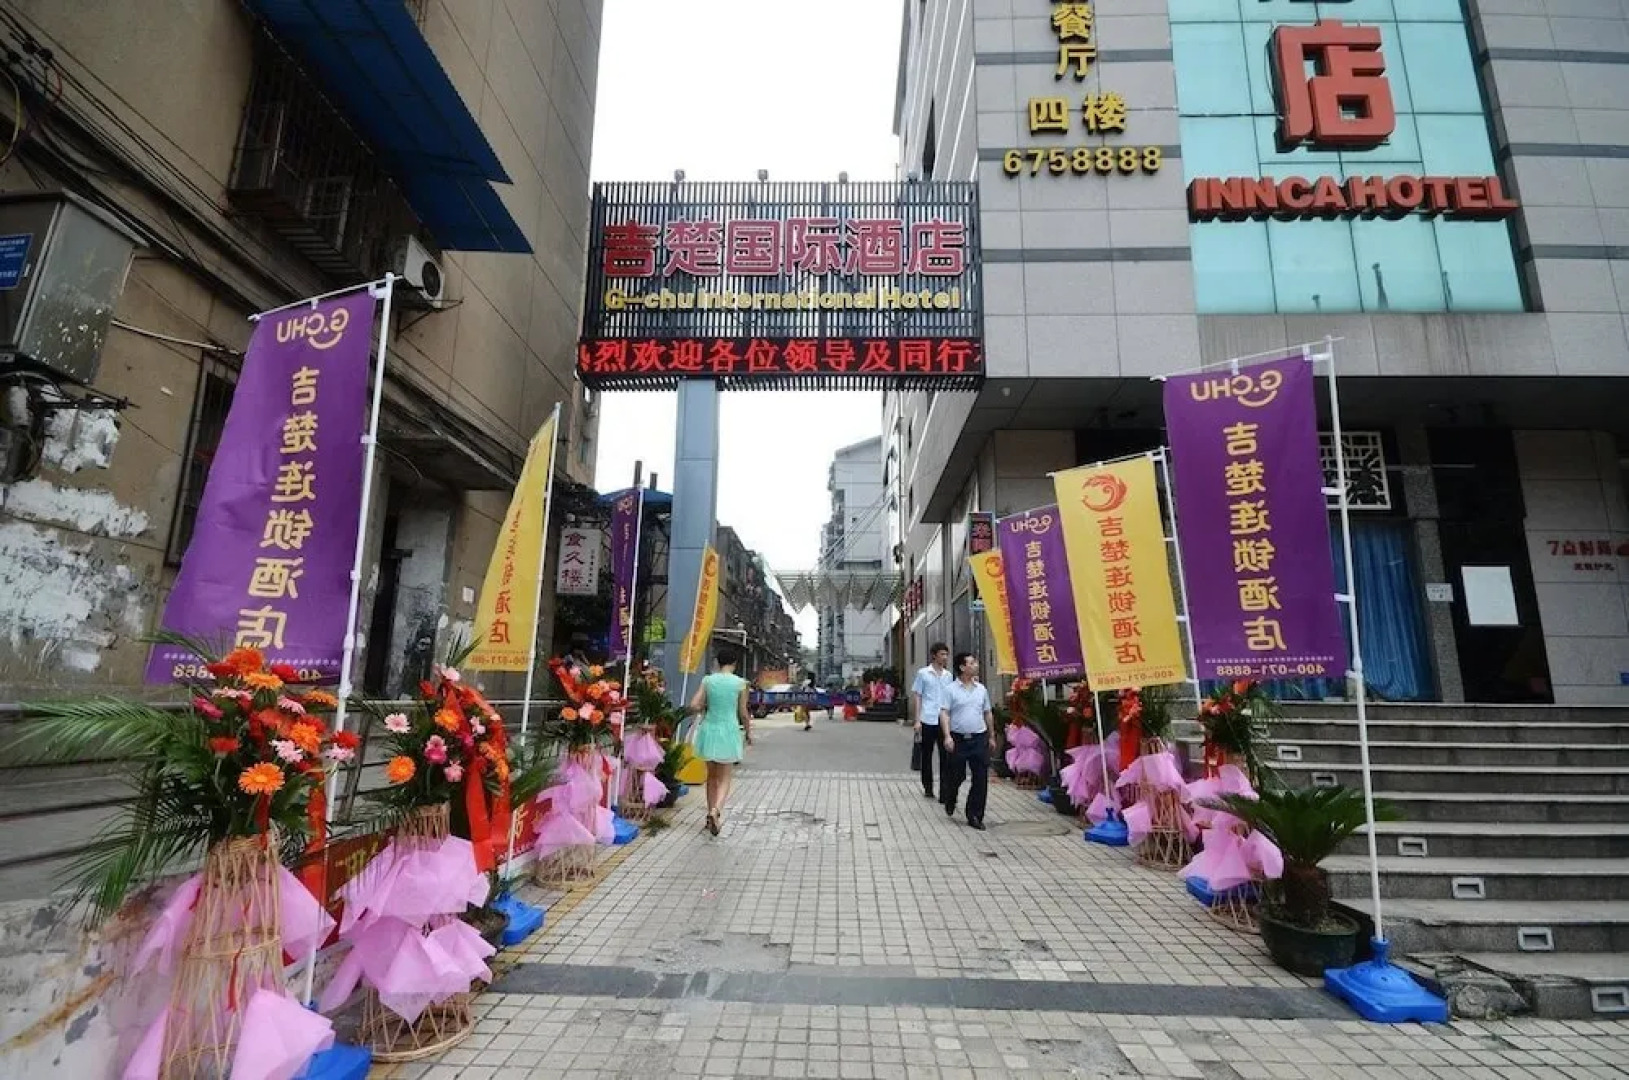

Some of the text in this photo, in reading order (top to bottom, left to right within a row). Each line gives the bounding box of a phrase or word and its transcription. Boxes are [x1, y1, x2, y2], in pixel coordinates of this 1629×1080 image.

[1052, 3, 1097, 78] 餐厅
[1028, 91, 1127, 133] 四楼
[1003, 146, 1163, 176] 6758888
[1350, 175, 1518, 216] HOTEL
[603, 217, 966, 277] 吉楚国际酒店
[883, 286, 961, 310] Hotel
[580, 338, 982, 374] 烈欢迎各位领导及同行
